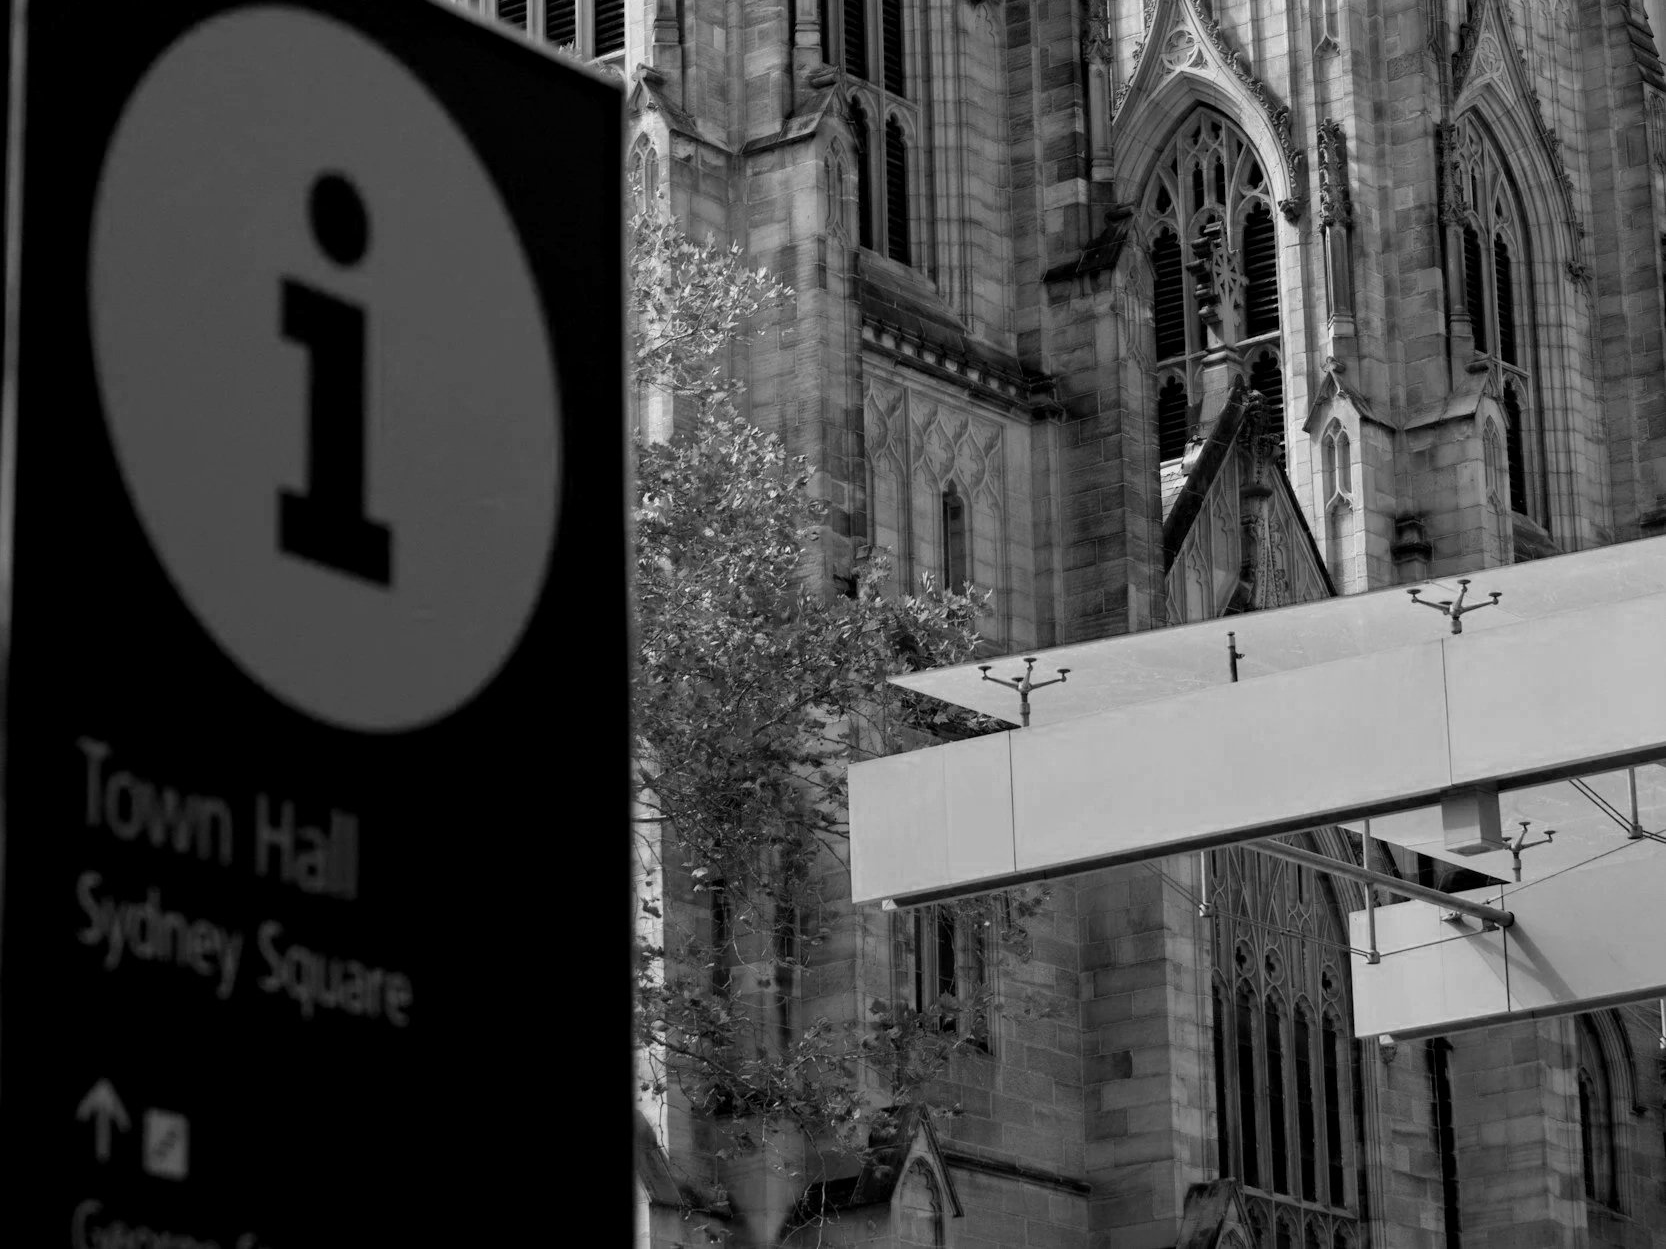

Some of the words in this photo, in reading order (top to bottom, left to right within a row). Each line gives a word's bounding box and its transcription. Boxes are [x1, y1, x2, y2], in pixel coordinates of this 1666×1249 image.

[277, 170, 394, 590] i
[76, 735, 234, 867] Town
[254, 791, 360, 900] Hall
[76, 870, 243, 1000] Sydney
[257, 920, 413, 1028] Square
